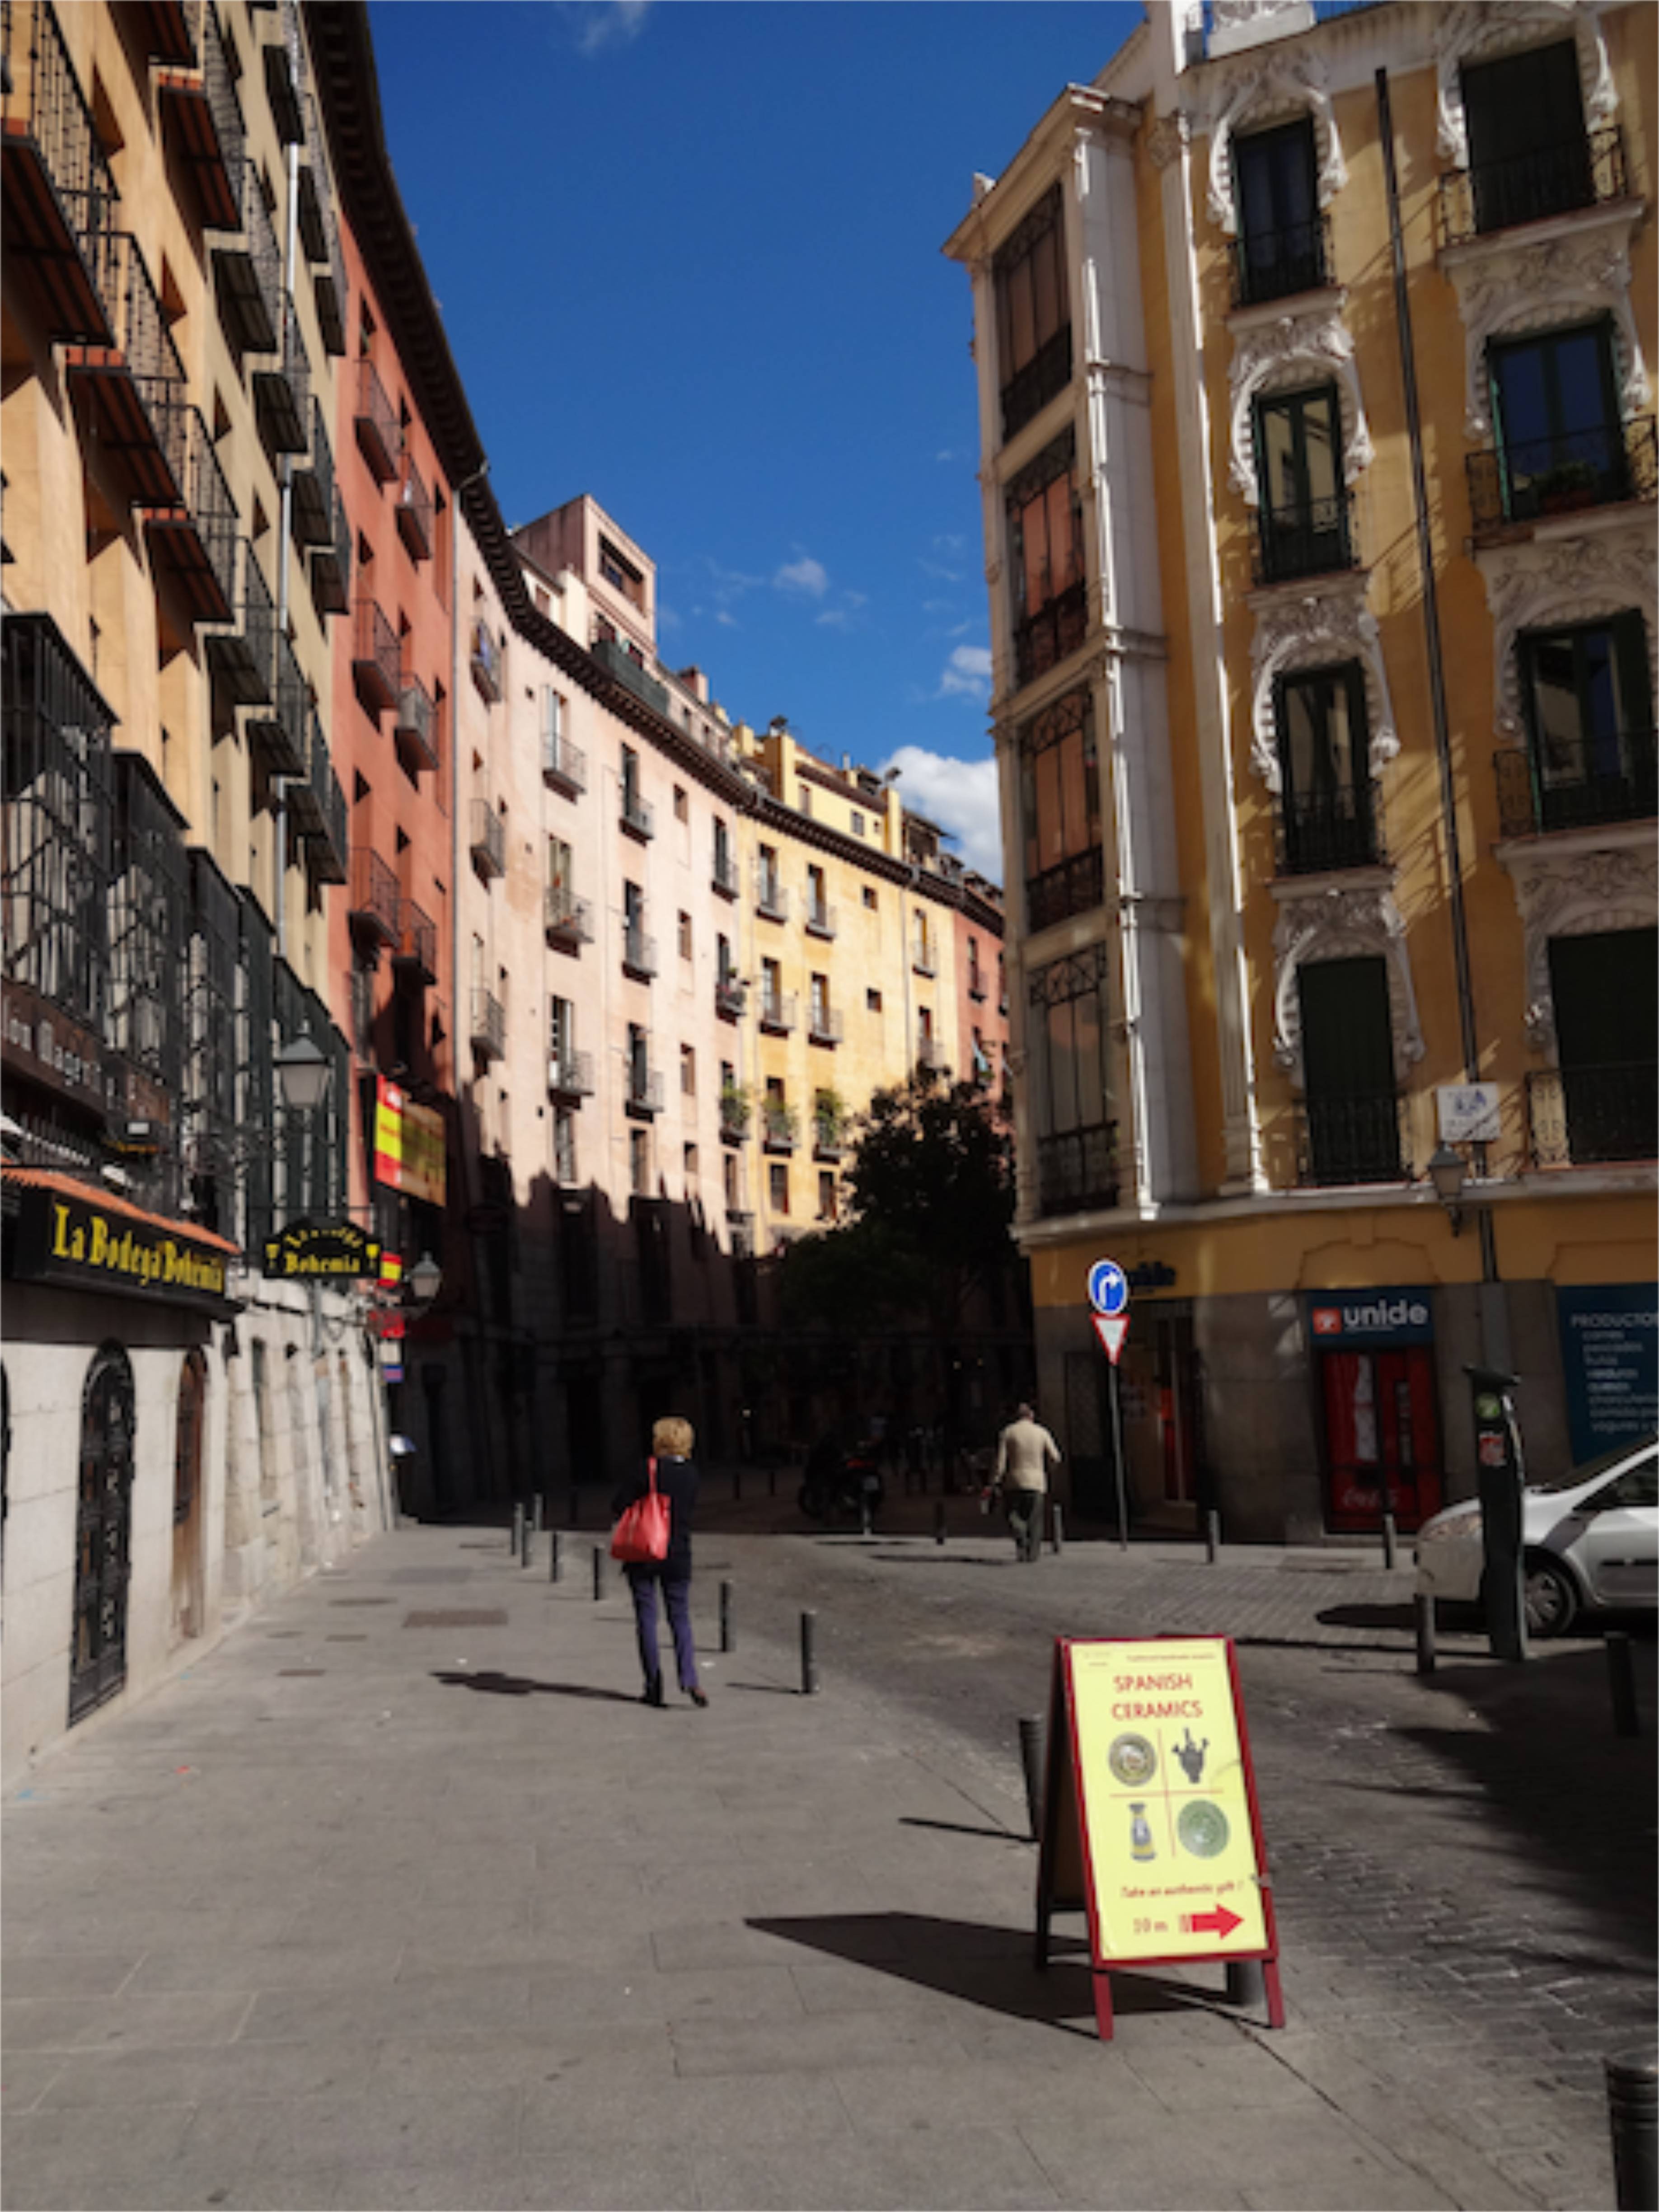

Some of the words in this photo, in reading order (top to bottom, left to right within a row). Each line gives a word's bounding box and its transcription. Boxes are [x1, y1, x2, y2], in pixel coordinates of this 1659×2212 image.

[52, 1204, 85, 1260] La
[88, 1215, 161, 1287] Bodega
[162, 1240, 224, 1293] Bohemia
[285, 1251, 361, 1274] Bohemia
[1343, 1298, 1429, 1326] unide
[1113, 1672, 1194, 1693] SPANISH
[1111, 1700, 1204, 1721] CERAMICS
